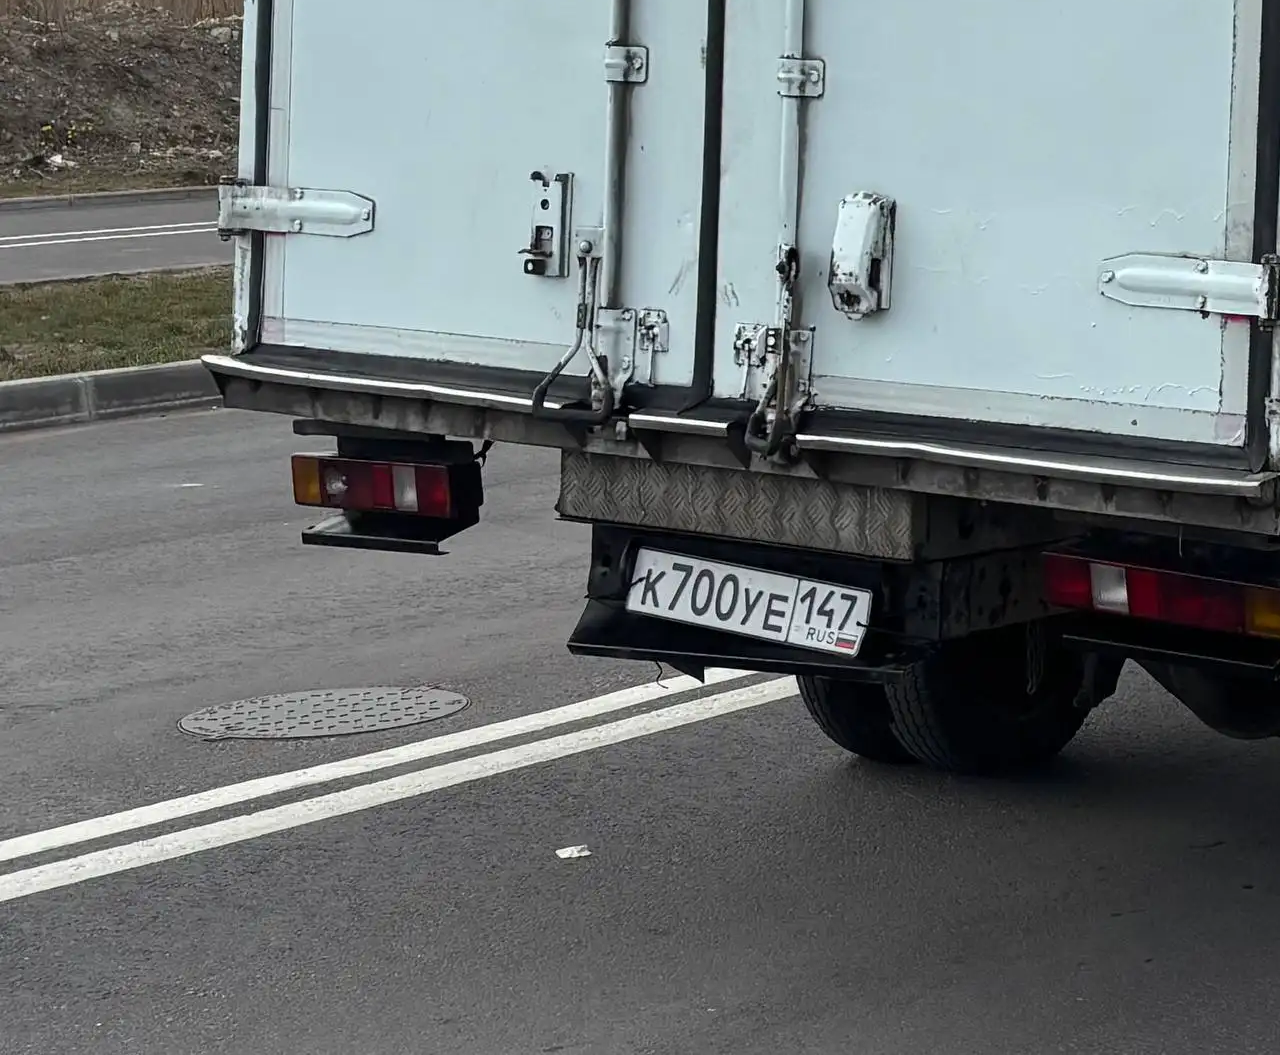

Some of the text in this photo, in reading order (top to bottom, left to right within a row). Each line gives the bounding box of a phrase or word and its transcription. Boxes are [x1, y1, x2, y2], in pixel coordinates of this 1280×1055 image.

[641, 563, 858, 633] К700УЕ 147
[805, 627, 836, 645] RUS
